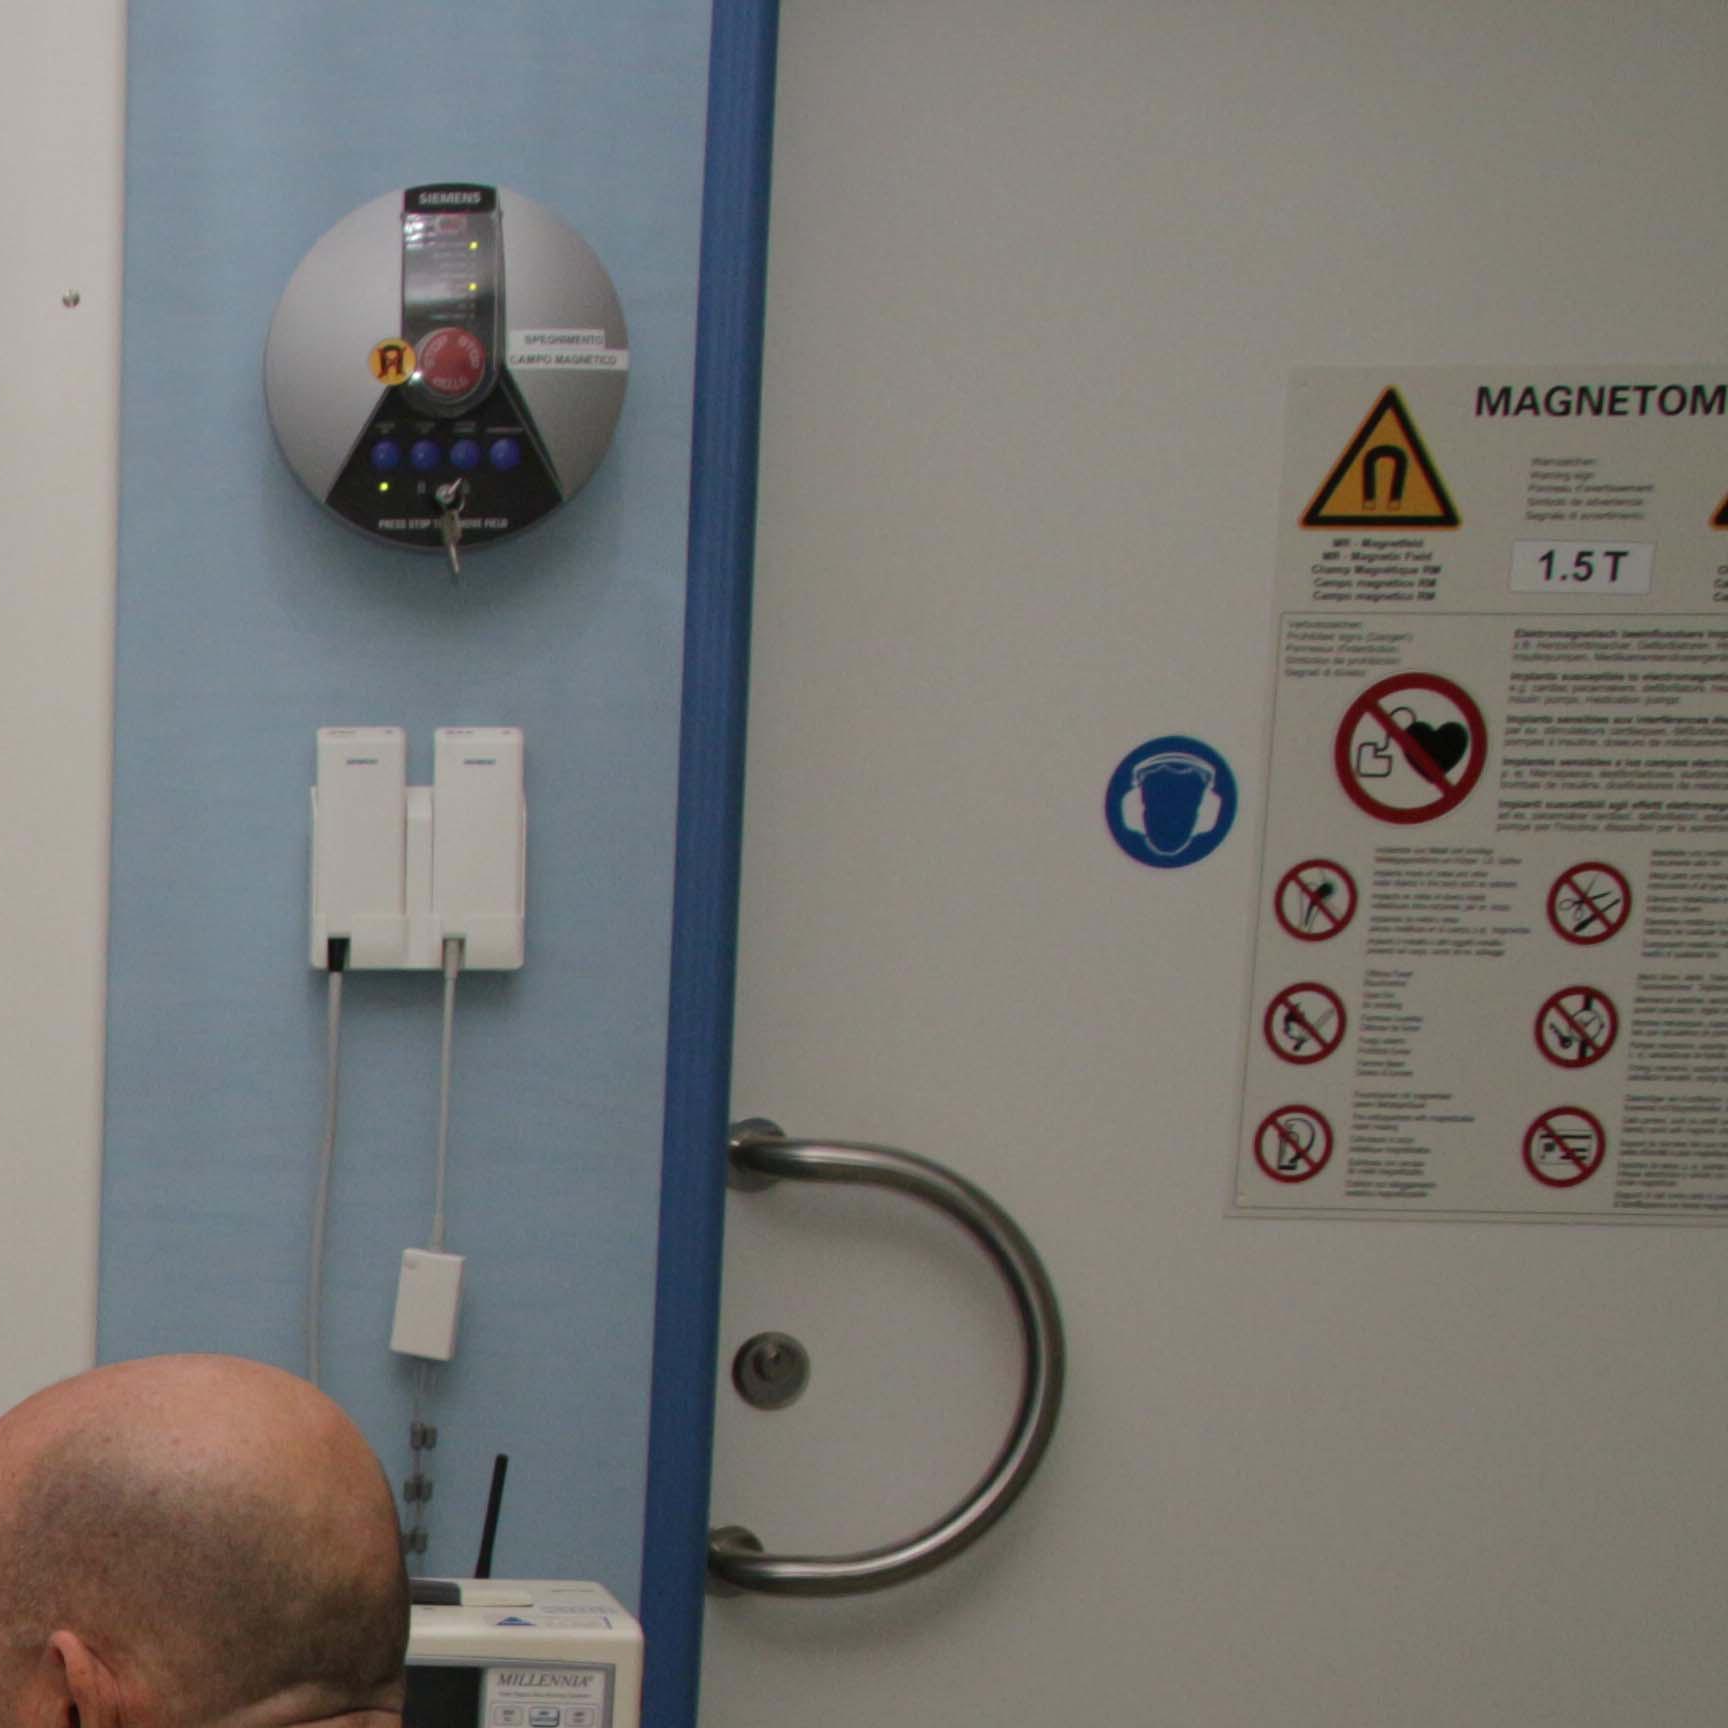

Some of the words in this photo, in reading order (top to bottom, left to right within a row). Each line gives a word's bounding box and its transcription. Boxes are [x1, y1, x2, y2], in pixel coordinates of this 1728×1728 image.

[418, 191, 482, 205] SIEMENS
[1475, 384, 1728, 416] MAGNETOM
[1538, 548, 1596, 582] 1.5
[1602, 550, 1630, 583] T
